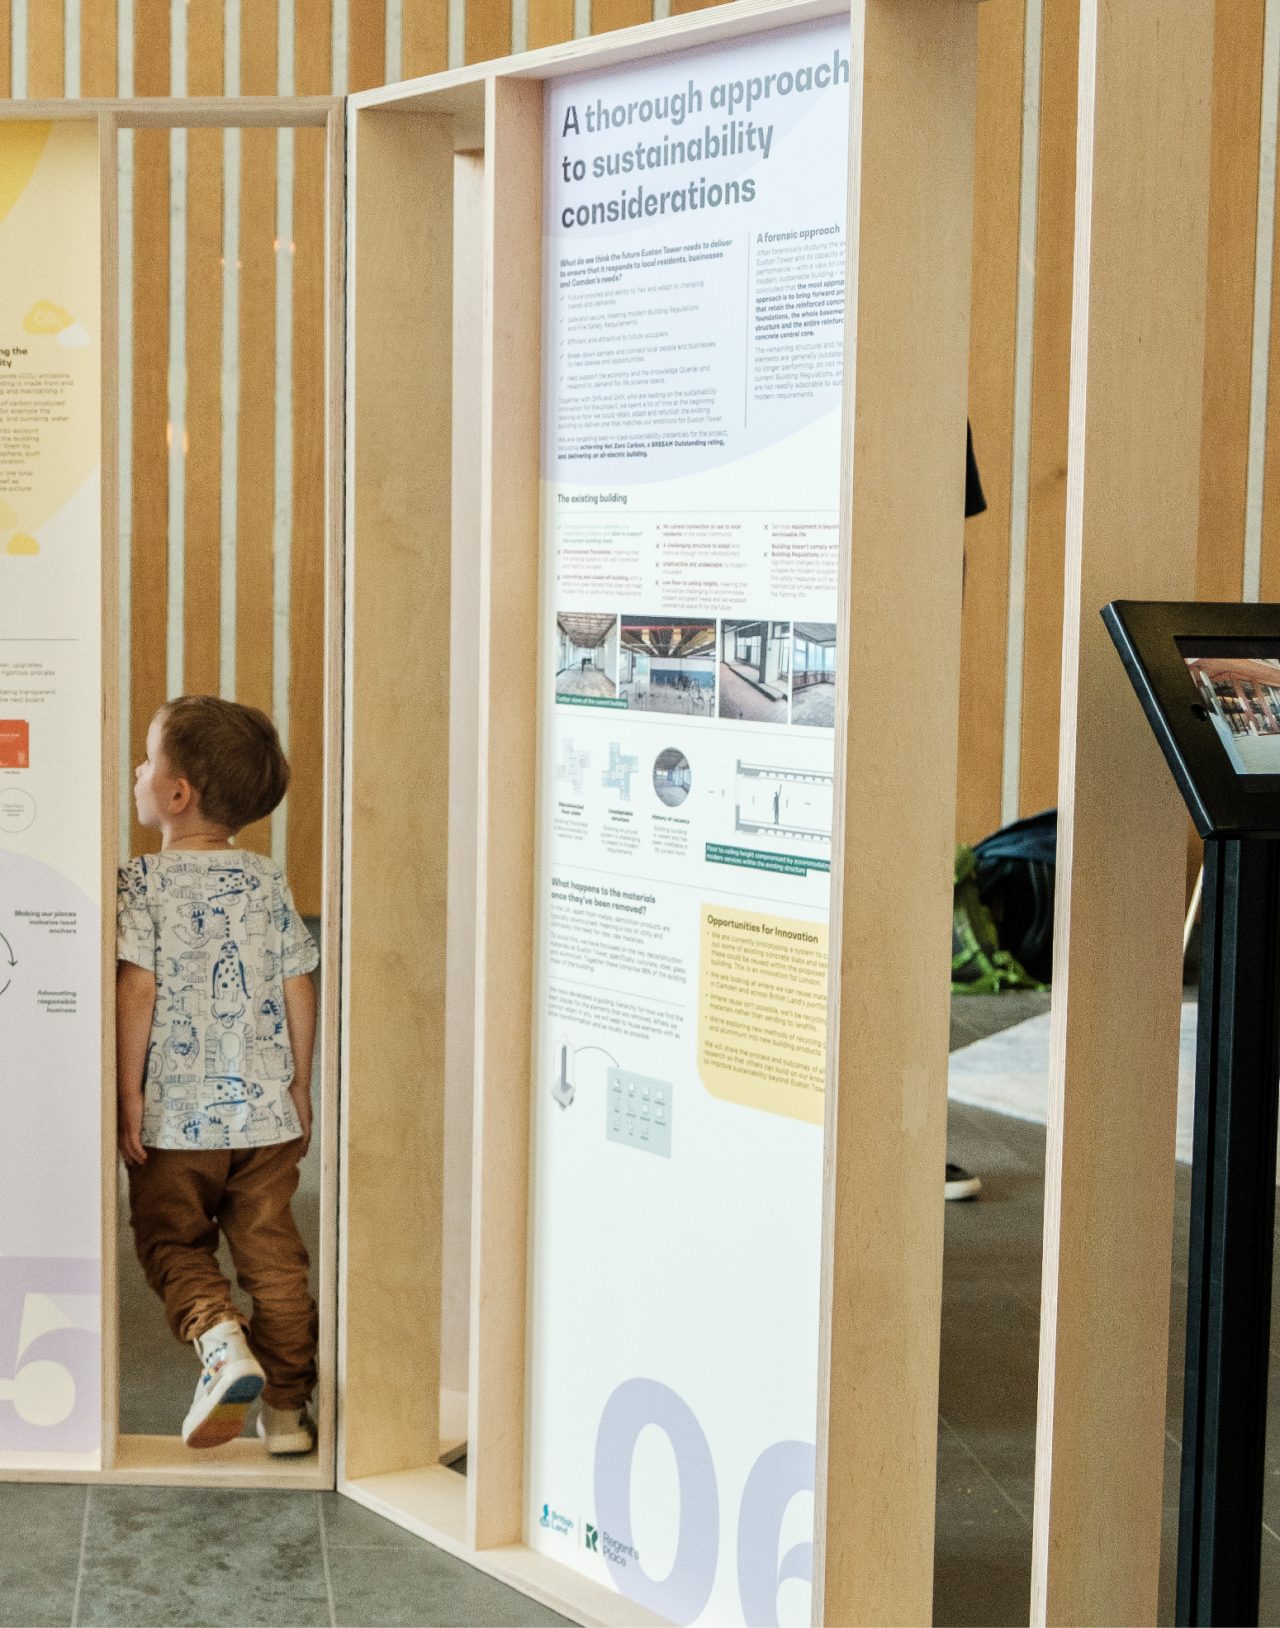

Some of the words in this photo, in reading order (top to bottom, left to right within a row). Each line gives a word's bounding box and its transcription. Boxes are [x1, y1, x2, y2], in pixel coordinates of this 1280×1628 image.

[562, 106, 580, 138] A
[585, 80, 703, 132] thorough
[710, 50, 850, 110] approach
[562, 156, 587, 183] to
[592, 122, 774, 178] sustainability
[562, 176, 756, 228] considerations
[757, 233, 763, 243] A
[764, 229, 797, 242] forensic
[799, 224, 840, 240] approach
[560, 269, 566, 278] to
[566, 268, 586, 277] ensure
[586, 265, 599, 274] that
[600, 264, 604, 273] it
[605, 261, 632, 273] responds
[633, 260, 640, 269] to
[641, 258, 656, 268] local
[656, 255, 687, 267] residents,
[688, 252, 723, 263] businesses
[561, 257, 576, 267] What
[576, 256, 584, 265] do
[595, 253, 609, 263] think
[610, 252, 620, 262] the
[621, 250, 640, 260] future
[640, 247, 662, 258] Euston
[663, 246, 681, 255] Tower
[682, 242, 701, 253] needs
[702, 241, 709, 251] to
[710, 239, 732, 250] deliver
[560, 278, 570, 288] and
[571, 276, 600, 287] Camden's
[600, 274, 622, 284] needs?
[558, 494, 569, 503] The
[570, 494, 598, 505] existing
[599, 494, 627, 505] building
[551, 878, 569, 889] What
[570, 881, 599, 894] happens
[601, 886, 608, 896] to
[609, 887, 620, 898] the
[622, 891, 656, 903] materials
[551, 894, 566, 902] once
[568, 894, 592, 906] they've
[593, 898, 610, 909] been
[611, 903, 646, 915] removed?
[707, 915, 760, 933] Opportunities
[761, 924, 773, 936] for
[774, 926, 818, 944] Innovation
[603, 1532, 639, 1560] Regent's
[603, 1546, 626, 1567] Place
